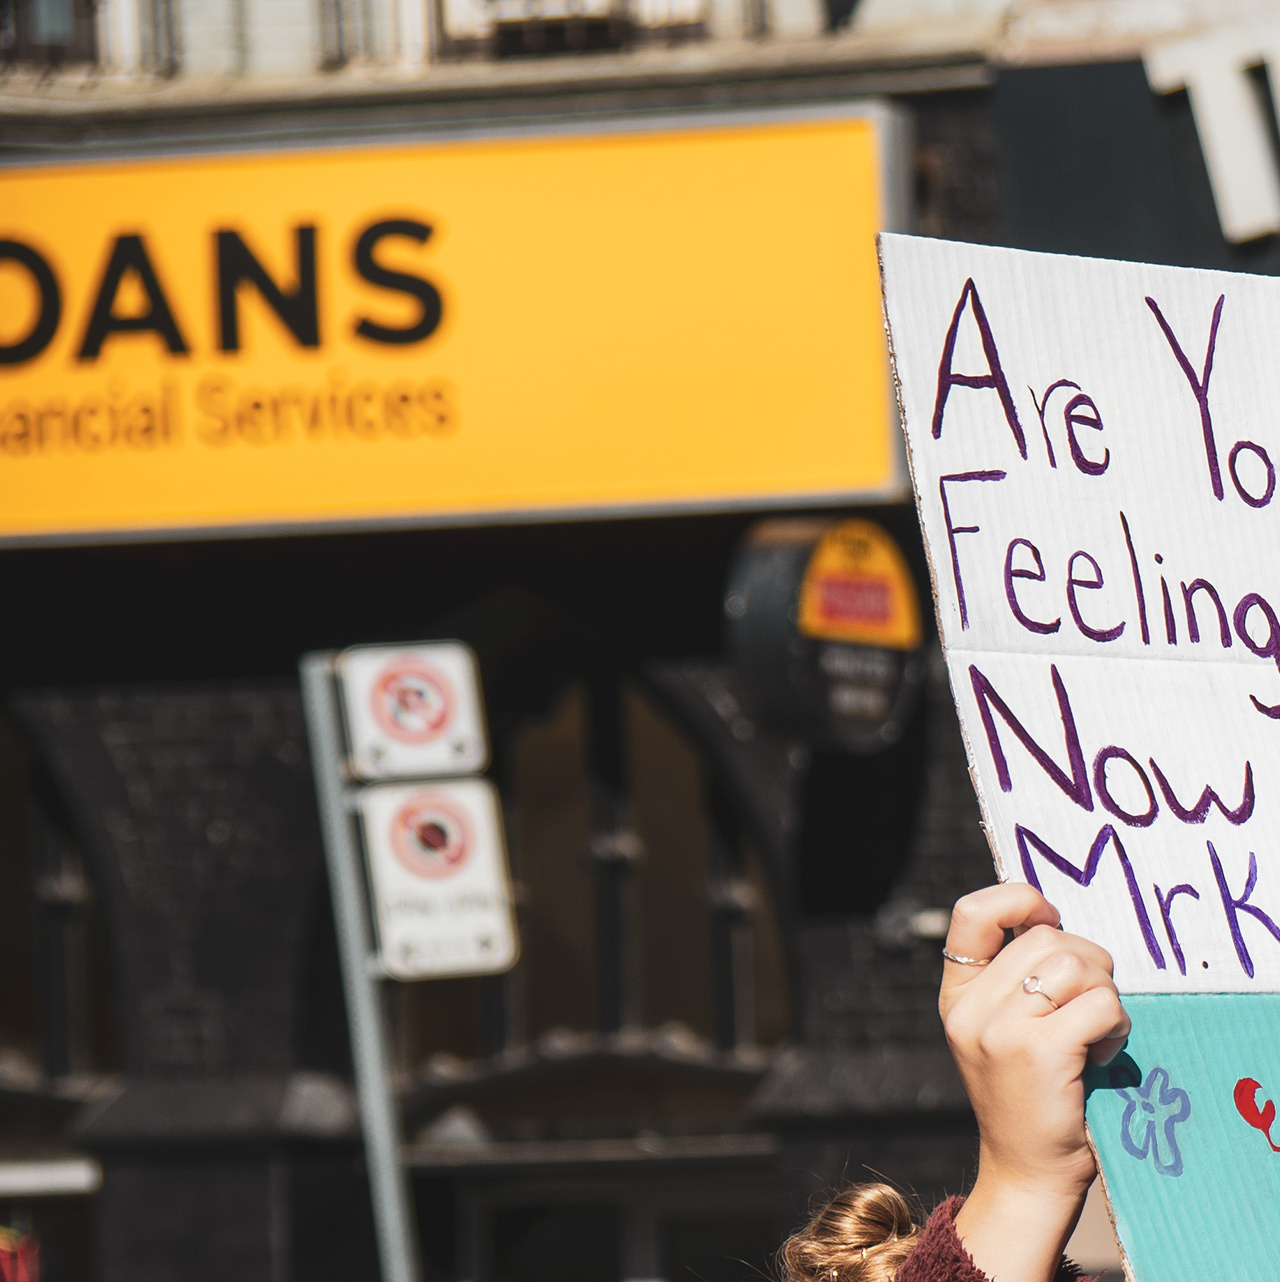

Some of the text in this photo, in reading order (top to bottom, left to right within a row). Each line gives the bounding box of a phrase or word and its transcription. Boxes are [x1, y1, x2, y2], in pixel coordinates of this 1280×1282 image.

[195, 367, 457, 450] Services
[933, 278, 1109, 477] Are
[968, 663, 1256, 828] Now
